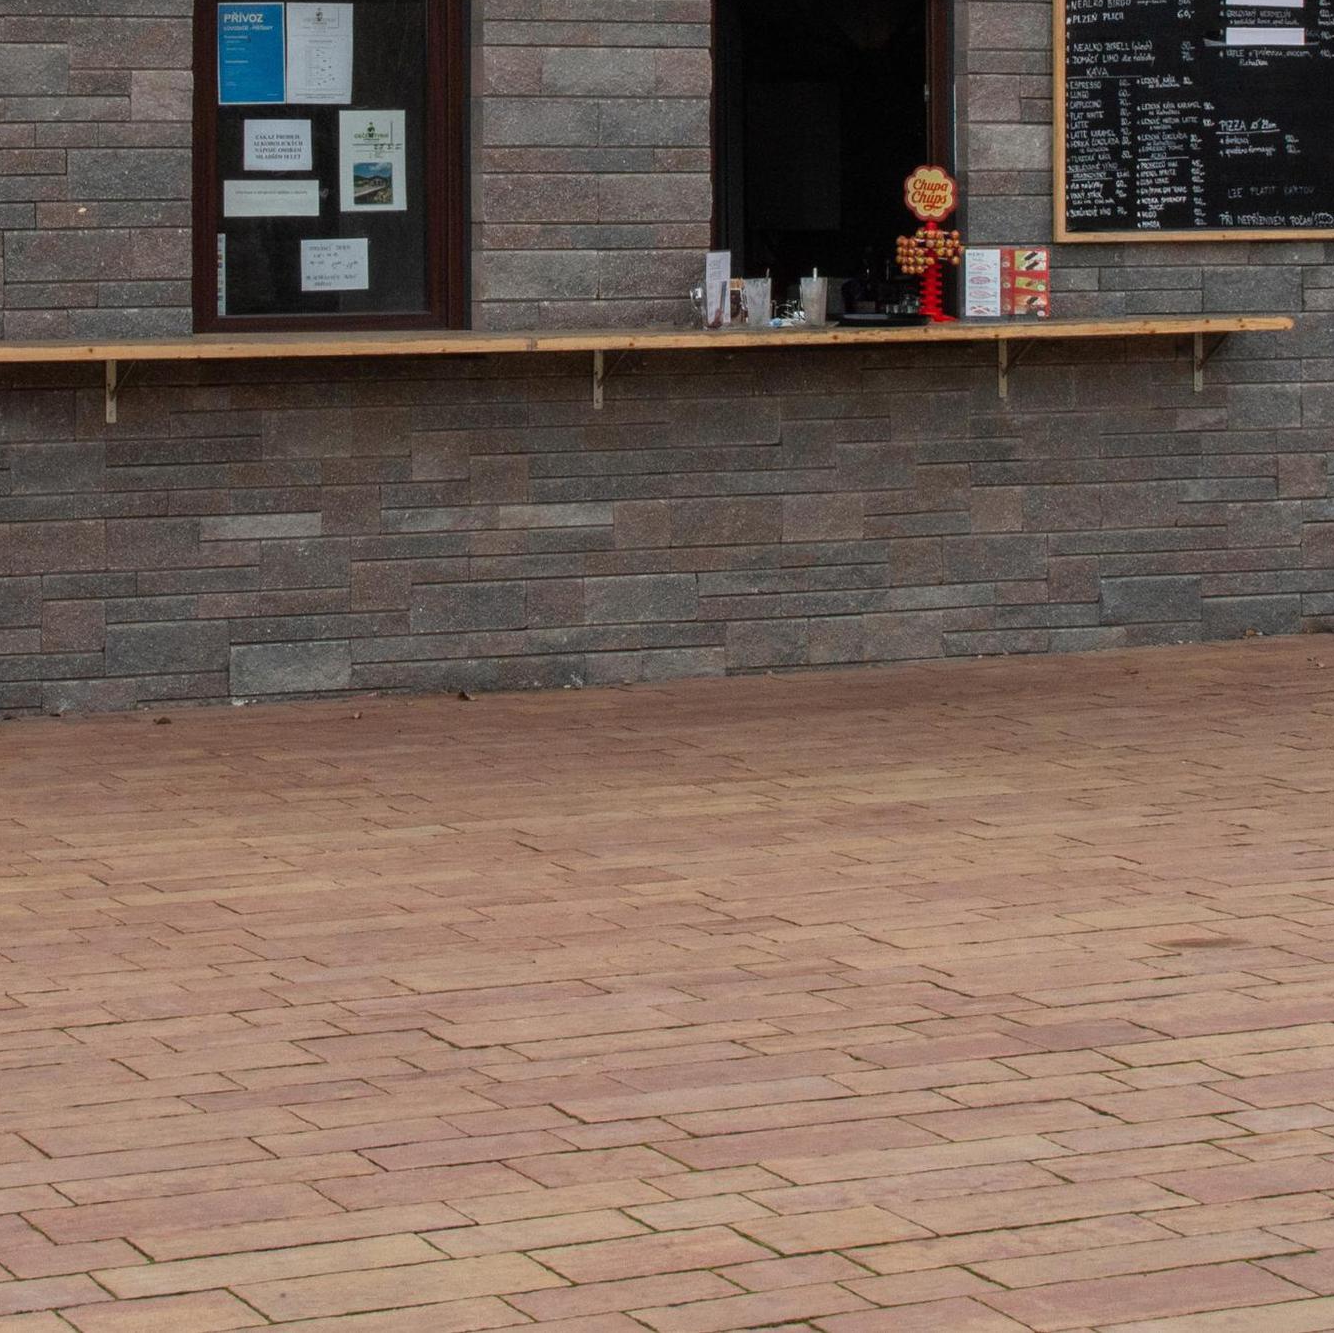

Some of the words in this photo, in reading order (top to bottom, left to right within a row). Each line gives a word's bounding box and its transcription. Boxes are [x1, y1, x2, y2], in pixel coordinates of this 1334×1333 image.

[224, 11, 264, 23] PŘÍVOZ
[1219, 120, 1246, 131] PIZZA
[913, 179, 948, 193] Chupa
[912, 191, 947, 211] Chups
